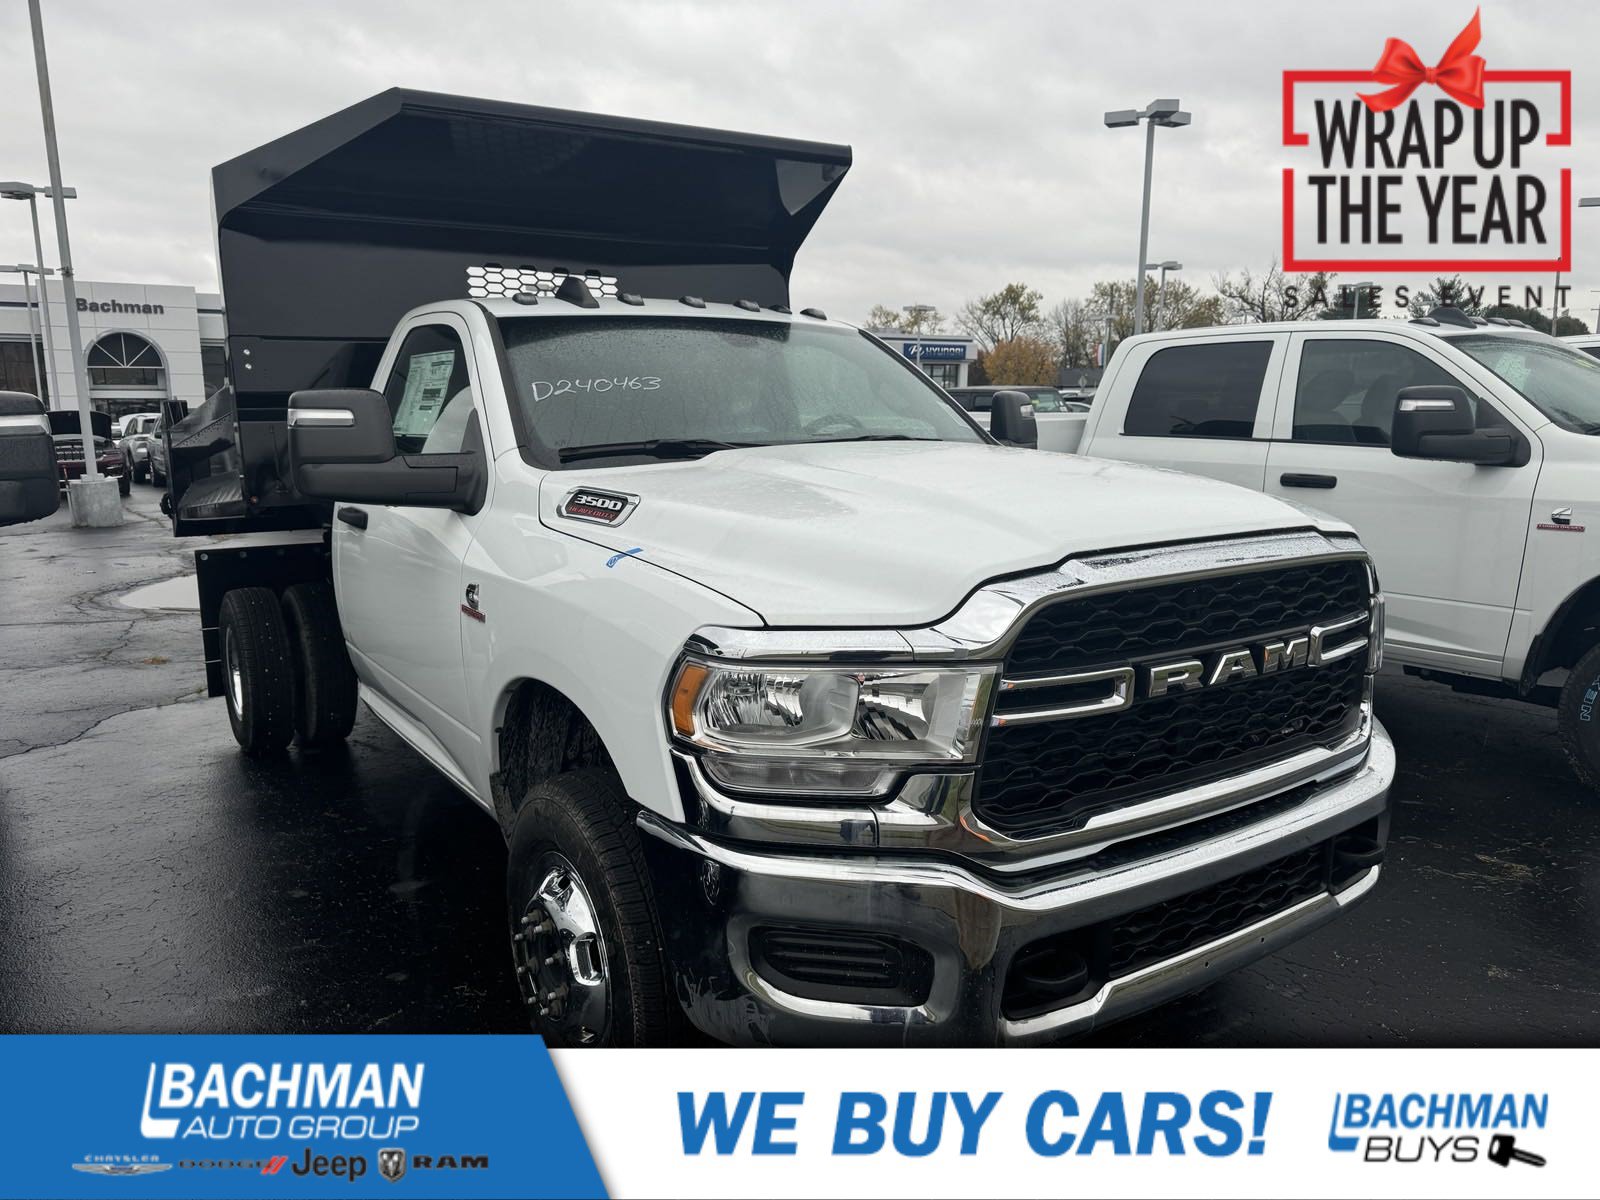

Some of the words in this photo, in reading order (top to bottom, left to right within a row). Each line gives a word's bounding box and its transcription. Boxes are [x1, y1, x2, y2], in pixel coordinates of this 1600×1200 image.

[76, 298, 164, 314] Bachman
[531, 376, 662, 402] D240463
[575, 494, 622, 511] 3500
[1149, 638, 1308, 697] RAM
